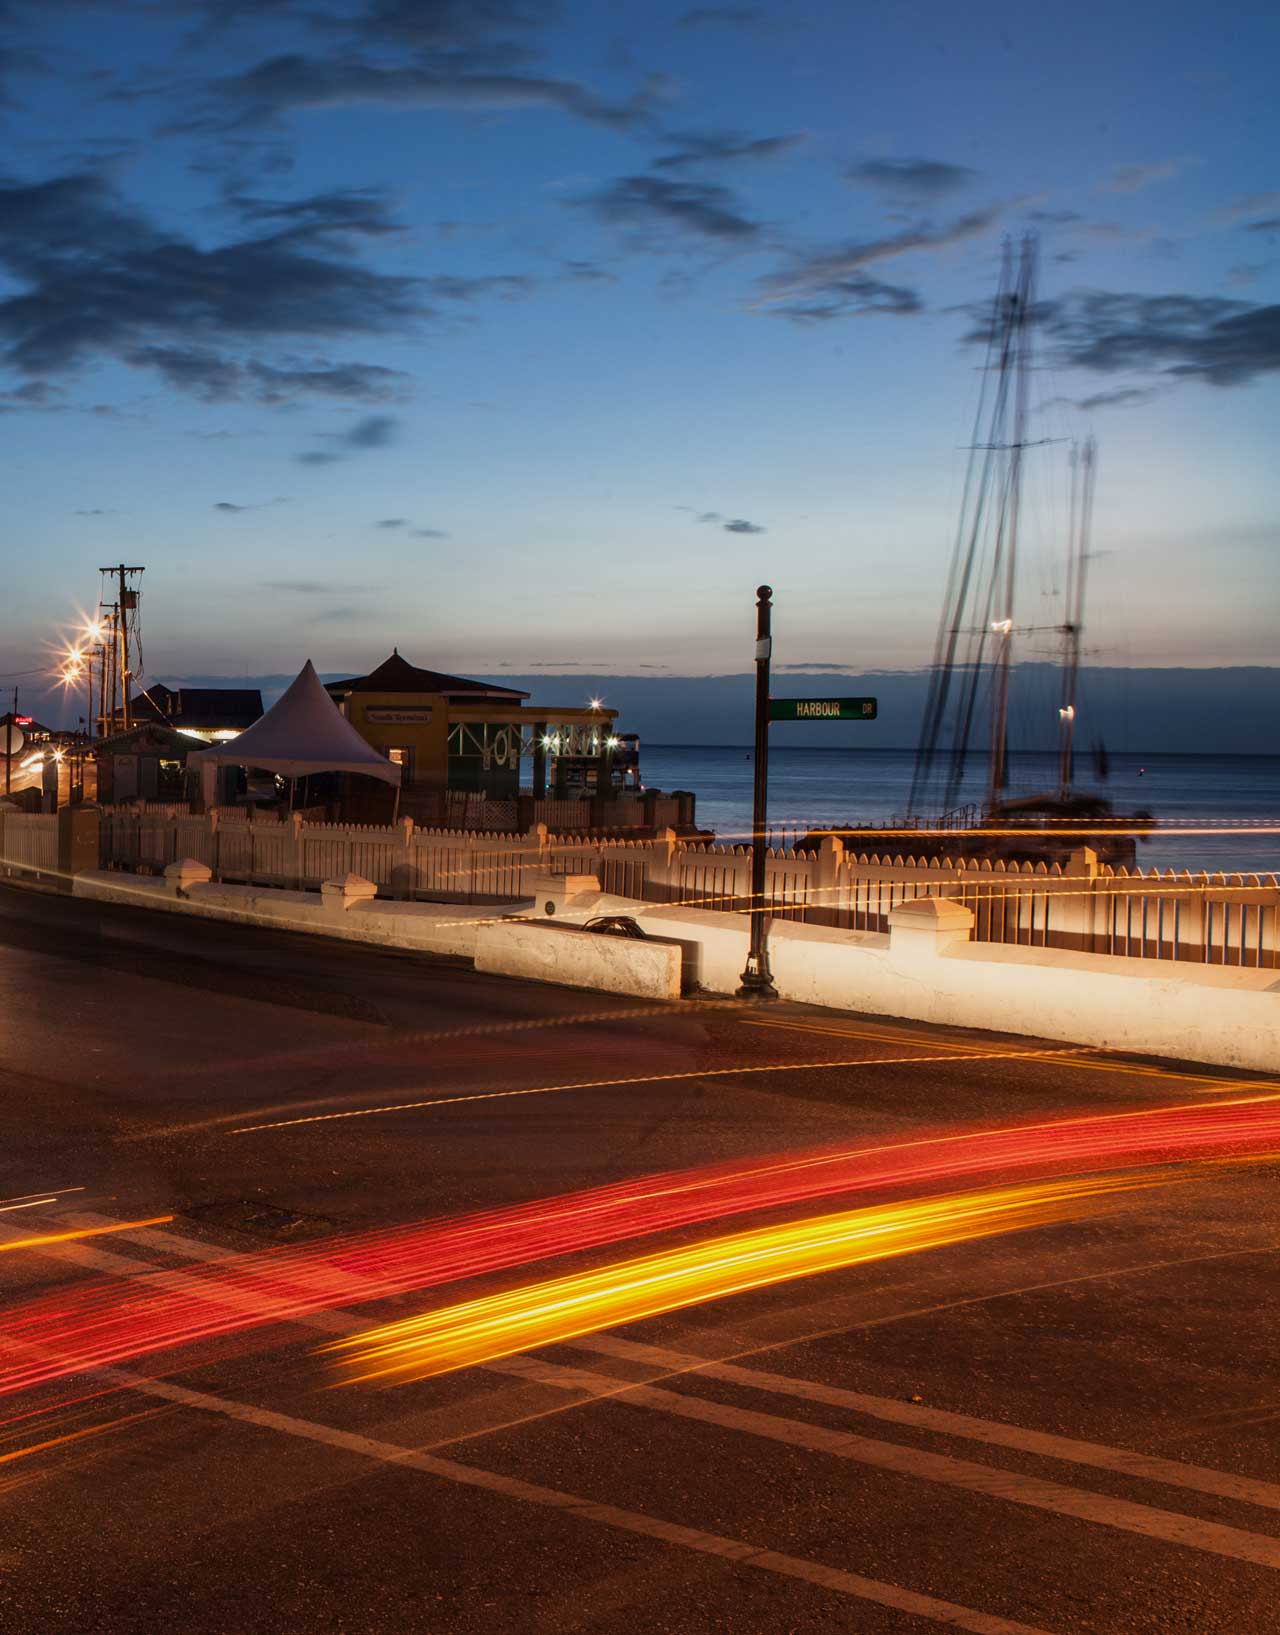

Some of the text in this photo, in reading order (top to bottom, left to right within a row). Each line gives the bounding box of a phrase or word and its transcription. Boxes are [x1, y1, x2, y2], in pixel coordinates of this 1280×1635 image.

[797, 701, 873, 717] HARBOUR DR
[394, 713, 431, 721] Terminal
